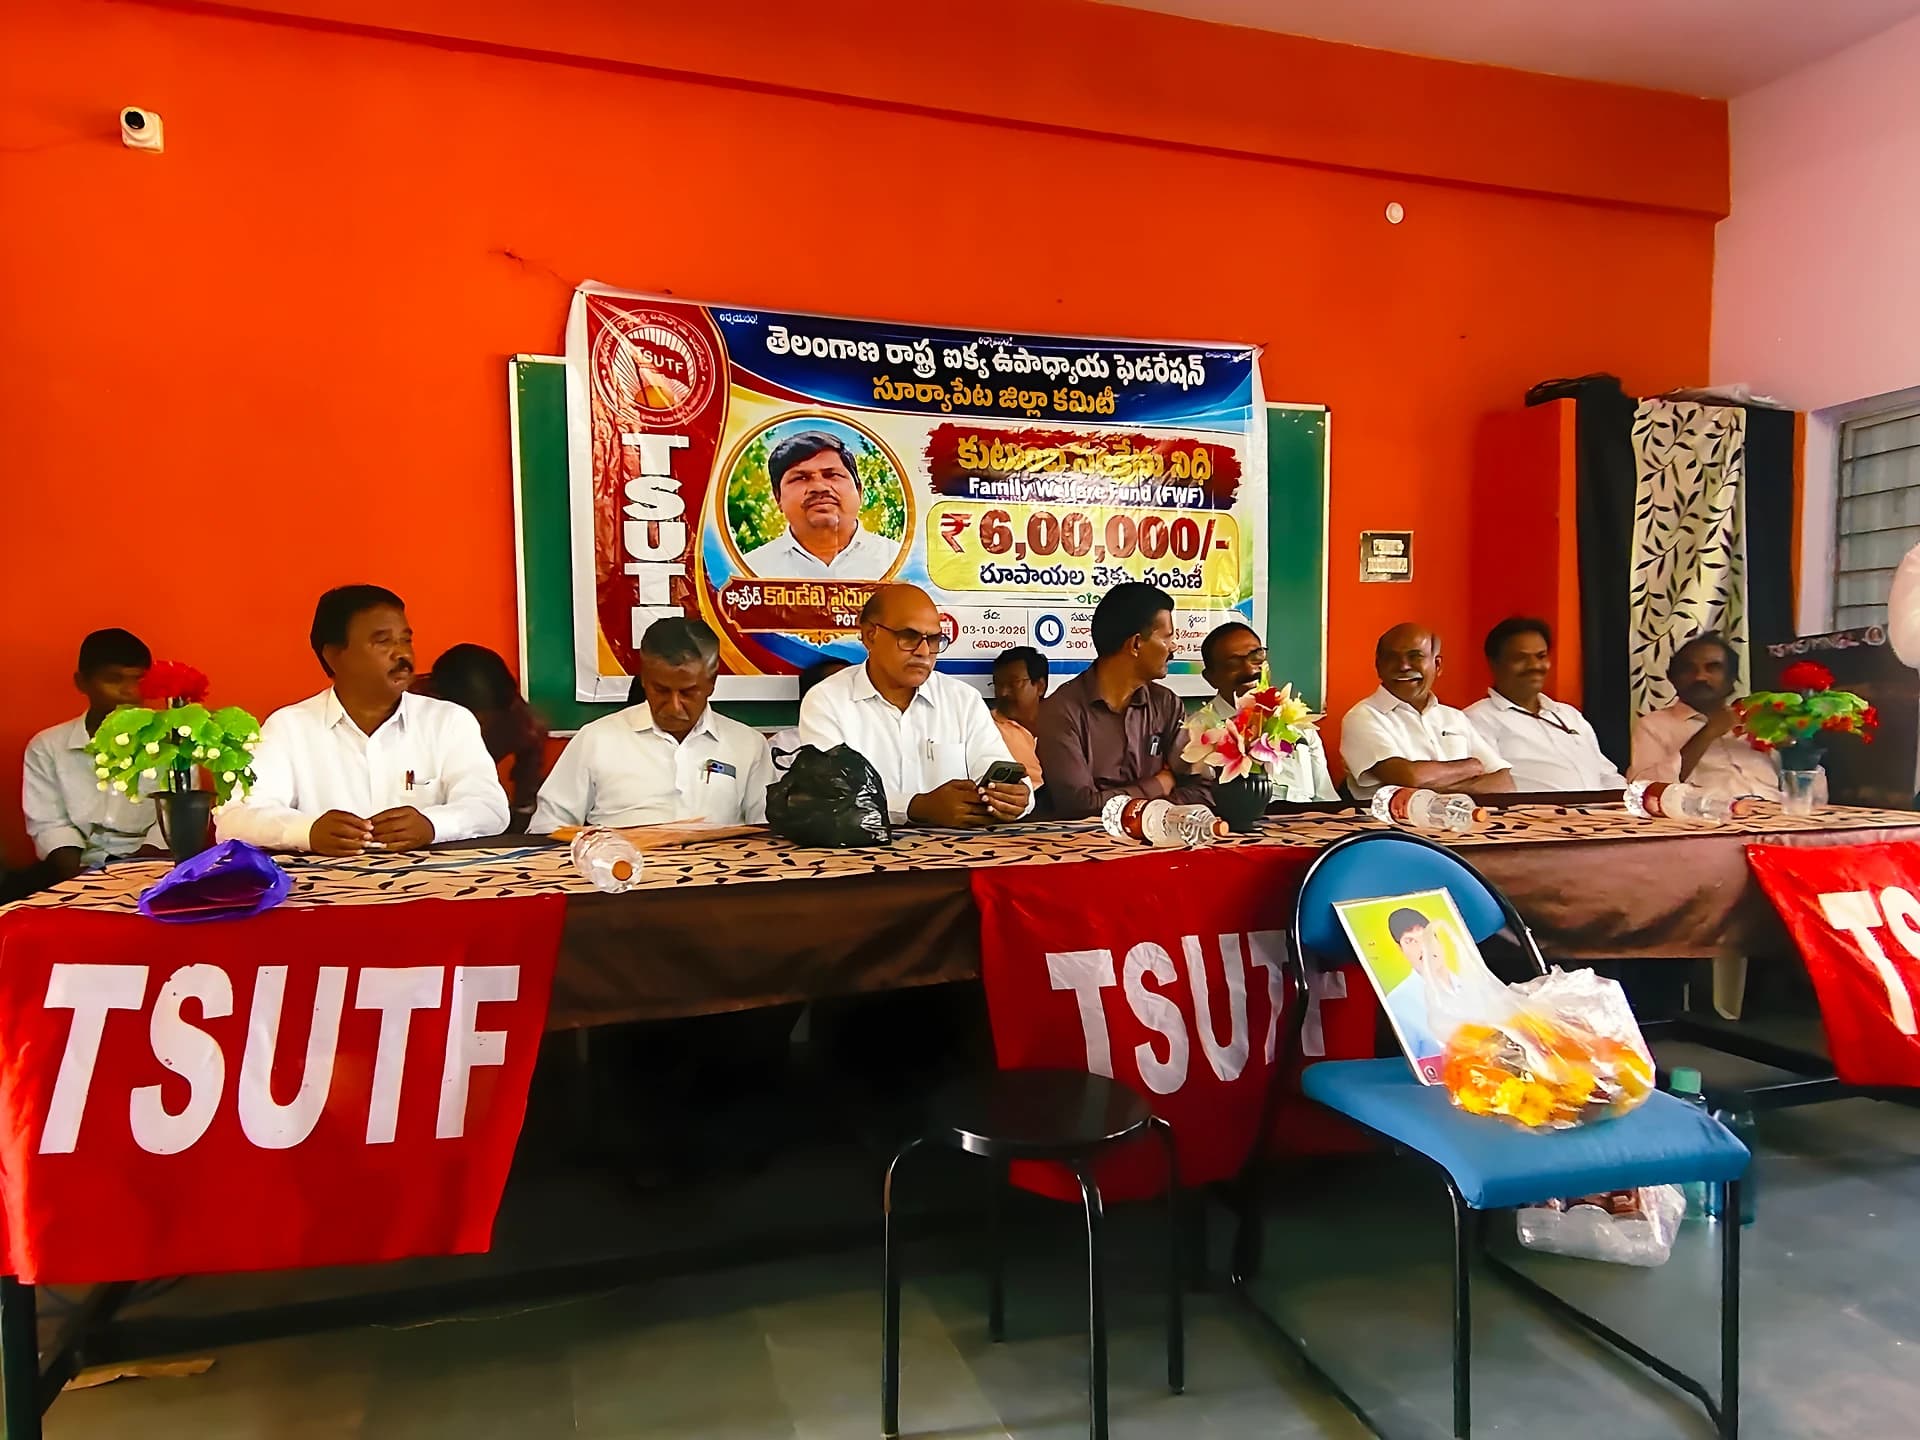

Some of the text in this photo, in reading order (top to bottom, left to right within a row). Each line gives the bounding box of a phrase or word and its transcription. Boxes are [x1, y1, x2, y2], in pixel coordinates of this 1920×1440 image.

[766, 324, 1206, 391] తెలంగాణ రాష్ట్ర ఐక్య ఉపాధ్యాయ ఫెడరేషన్
[872, 374, 1116, 418] సూర్యాపేట జిల్లా కమిటీ
[968, 477, 1030, 501] Family
[1156, 484, 1205, 507] (FWF)
[979, 509, 1231, 564] 6,00,000/-
[979, 562, 1085, 587] రూపాయల
[961, 625, 1026, 635] 03-10-2026
[38, 962, 521, 1156] TSUTF
